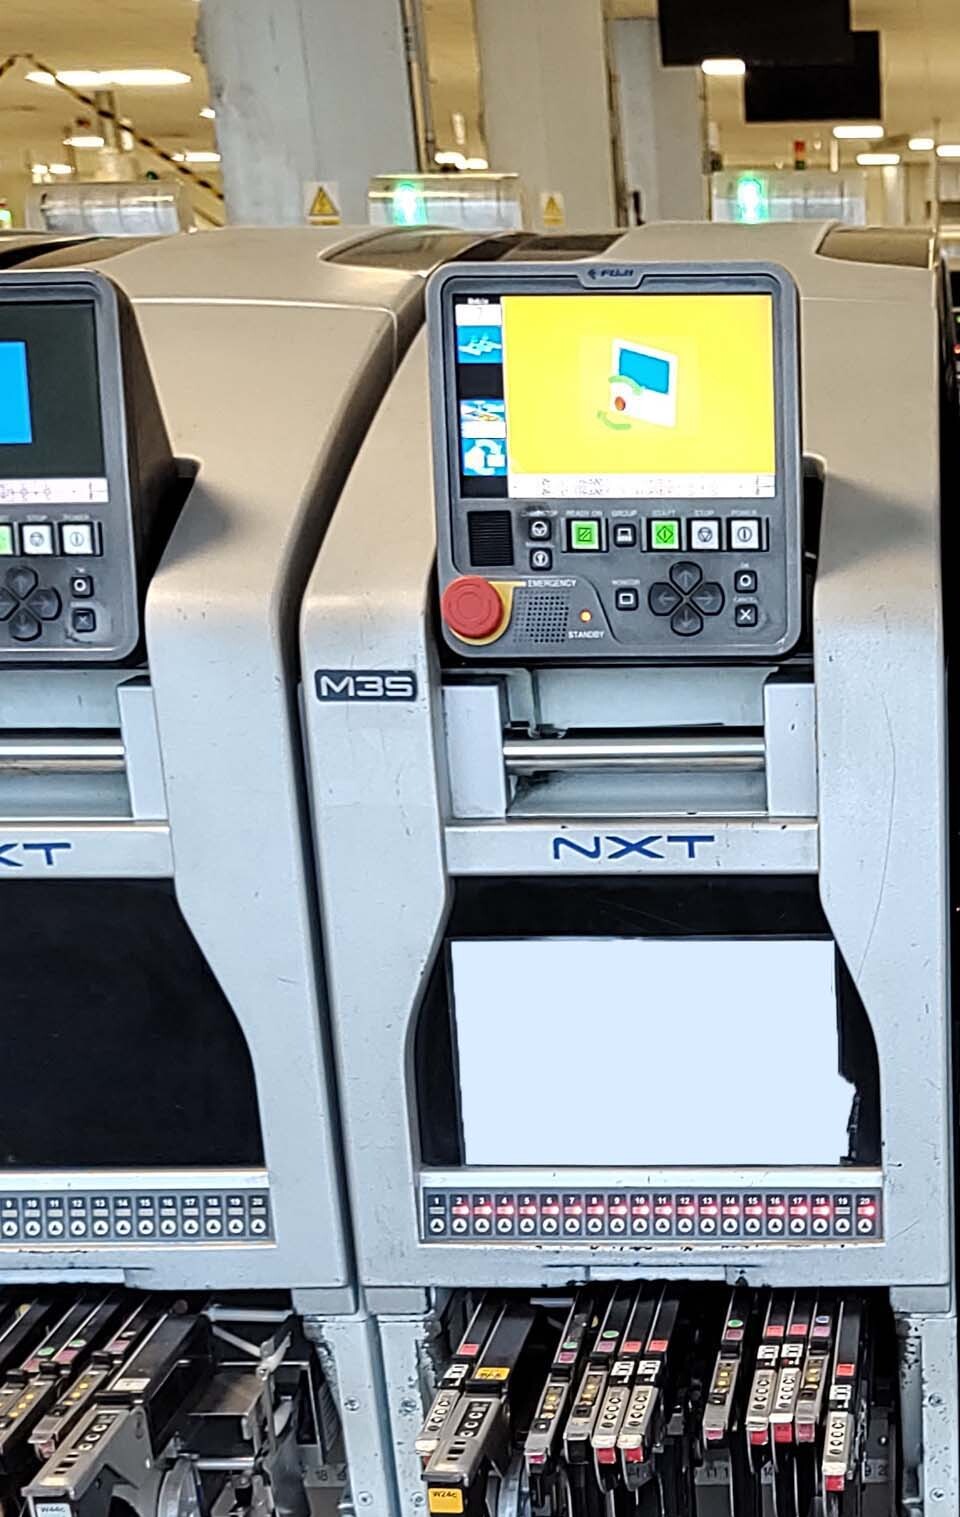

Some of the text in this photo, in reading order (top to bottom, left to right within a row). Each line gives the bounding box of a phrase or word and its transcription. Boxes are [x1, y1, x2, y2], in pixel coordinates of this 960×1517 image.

[611, 510, 638, 518] GROUP
[527, 579, 577, 588] EMERGENCY
[568, 630, 605, 639] STANDBY
[320, 675, 414, 698] M3S
[552, 834, 715, 860] NXT
[26, 1199, 37, 1208] 10
[49, 1199, 59, 1207] 11
[72, 1199, 83, 1208] 12
[95, 1199, 106, 1207] 13
[117, 1199, 128, 1207] 14
[140, 1199, 151, 1207] 15
[162, 1198, 173, 1207] 16
[185, 1198, 196, 1206] 17
[207, 1198, 218, 1206] 18
[230, 1198, 241, 1206] 19
[635, 1196, 645, 1205] 10
[658, 1197, 667, 1205] 11
[680, 1197, 690, 1205] 12
[702, 1197, 713, 1205] 13
[725, 1197, 735, 1205] 14
[748, 1197, 758, 1205] 15
[770, 1197, 780, 1205] 16
[793, 1197, 803, 1205] 17
[815, 1197, 825, 1205] 18
[838, 1197, 848, 1205] 19
[860, 1197, 870, 1205] 20
